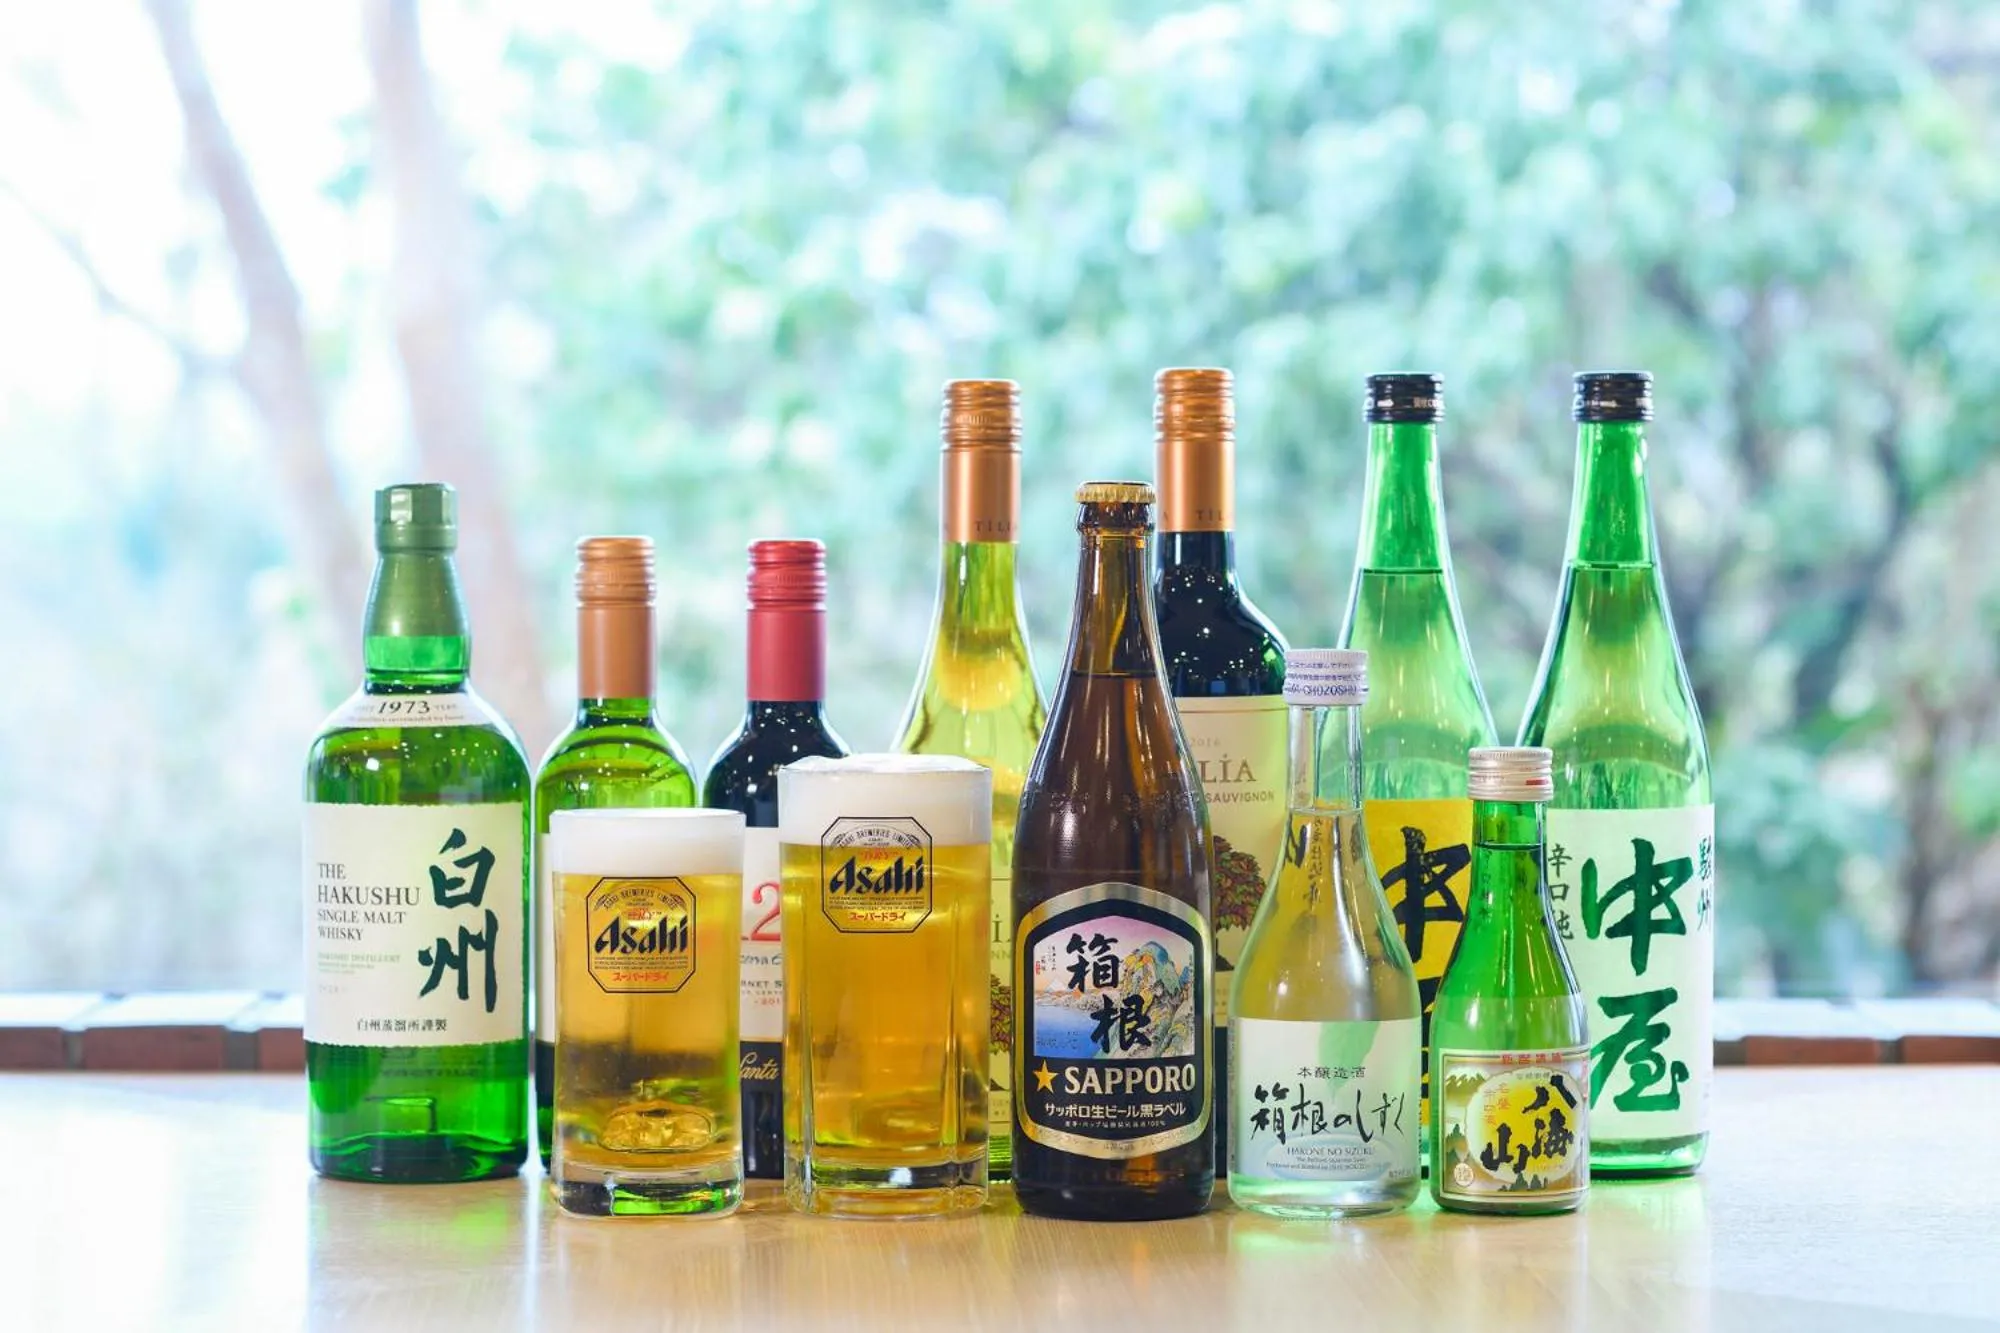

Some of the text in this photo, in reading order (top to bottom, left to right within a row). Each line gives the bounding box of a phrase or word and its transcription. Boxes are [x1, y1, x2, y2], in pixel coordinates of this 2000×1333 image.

[378, 700, 431, 714] 1973
[317, 861, 347, 880] THE
[829, 855, 925, 894] Asahi
[317, 884, 421, 906] HAKUSHU
[1382, 826, 1472, 964] 中
[317, 908, 406, 925] SINGLE MALT
[418, 827, 497, 1014] 白州
[317, 925, 363, 941] WHISKY
[594, 915, 688, 954] Asahi
[1066, 932, 1152, 1054] 箱根
[1064, 1063, 1196, 1095] SAPPORO
[1297, 1066, 1367, 1080] 本醸造酒
[1044, 1101, 1186, 1119] サッポロ生ビール黒ラベル
[1250, 1082, 1405, 1145] 箱根のしずく
[1480, 1075, 1578, 1174] 八海山
